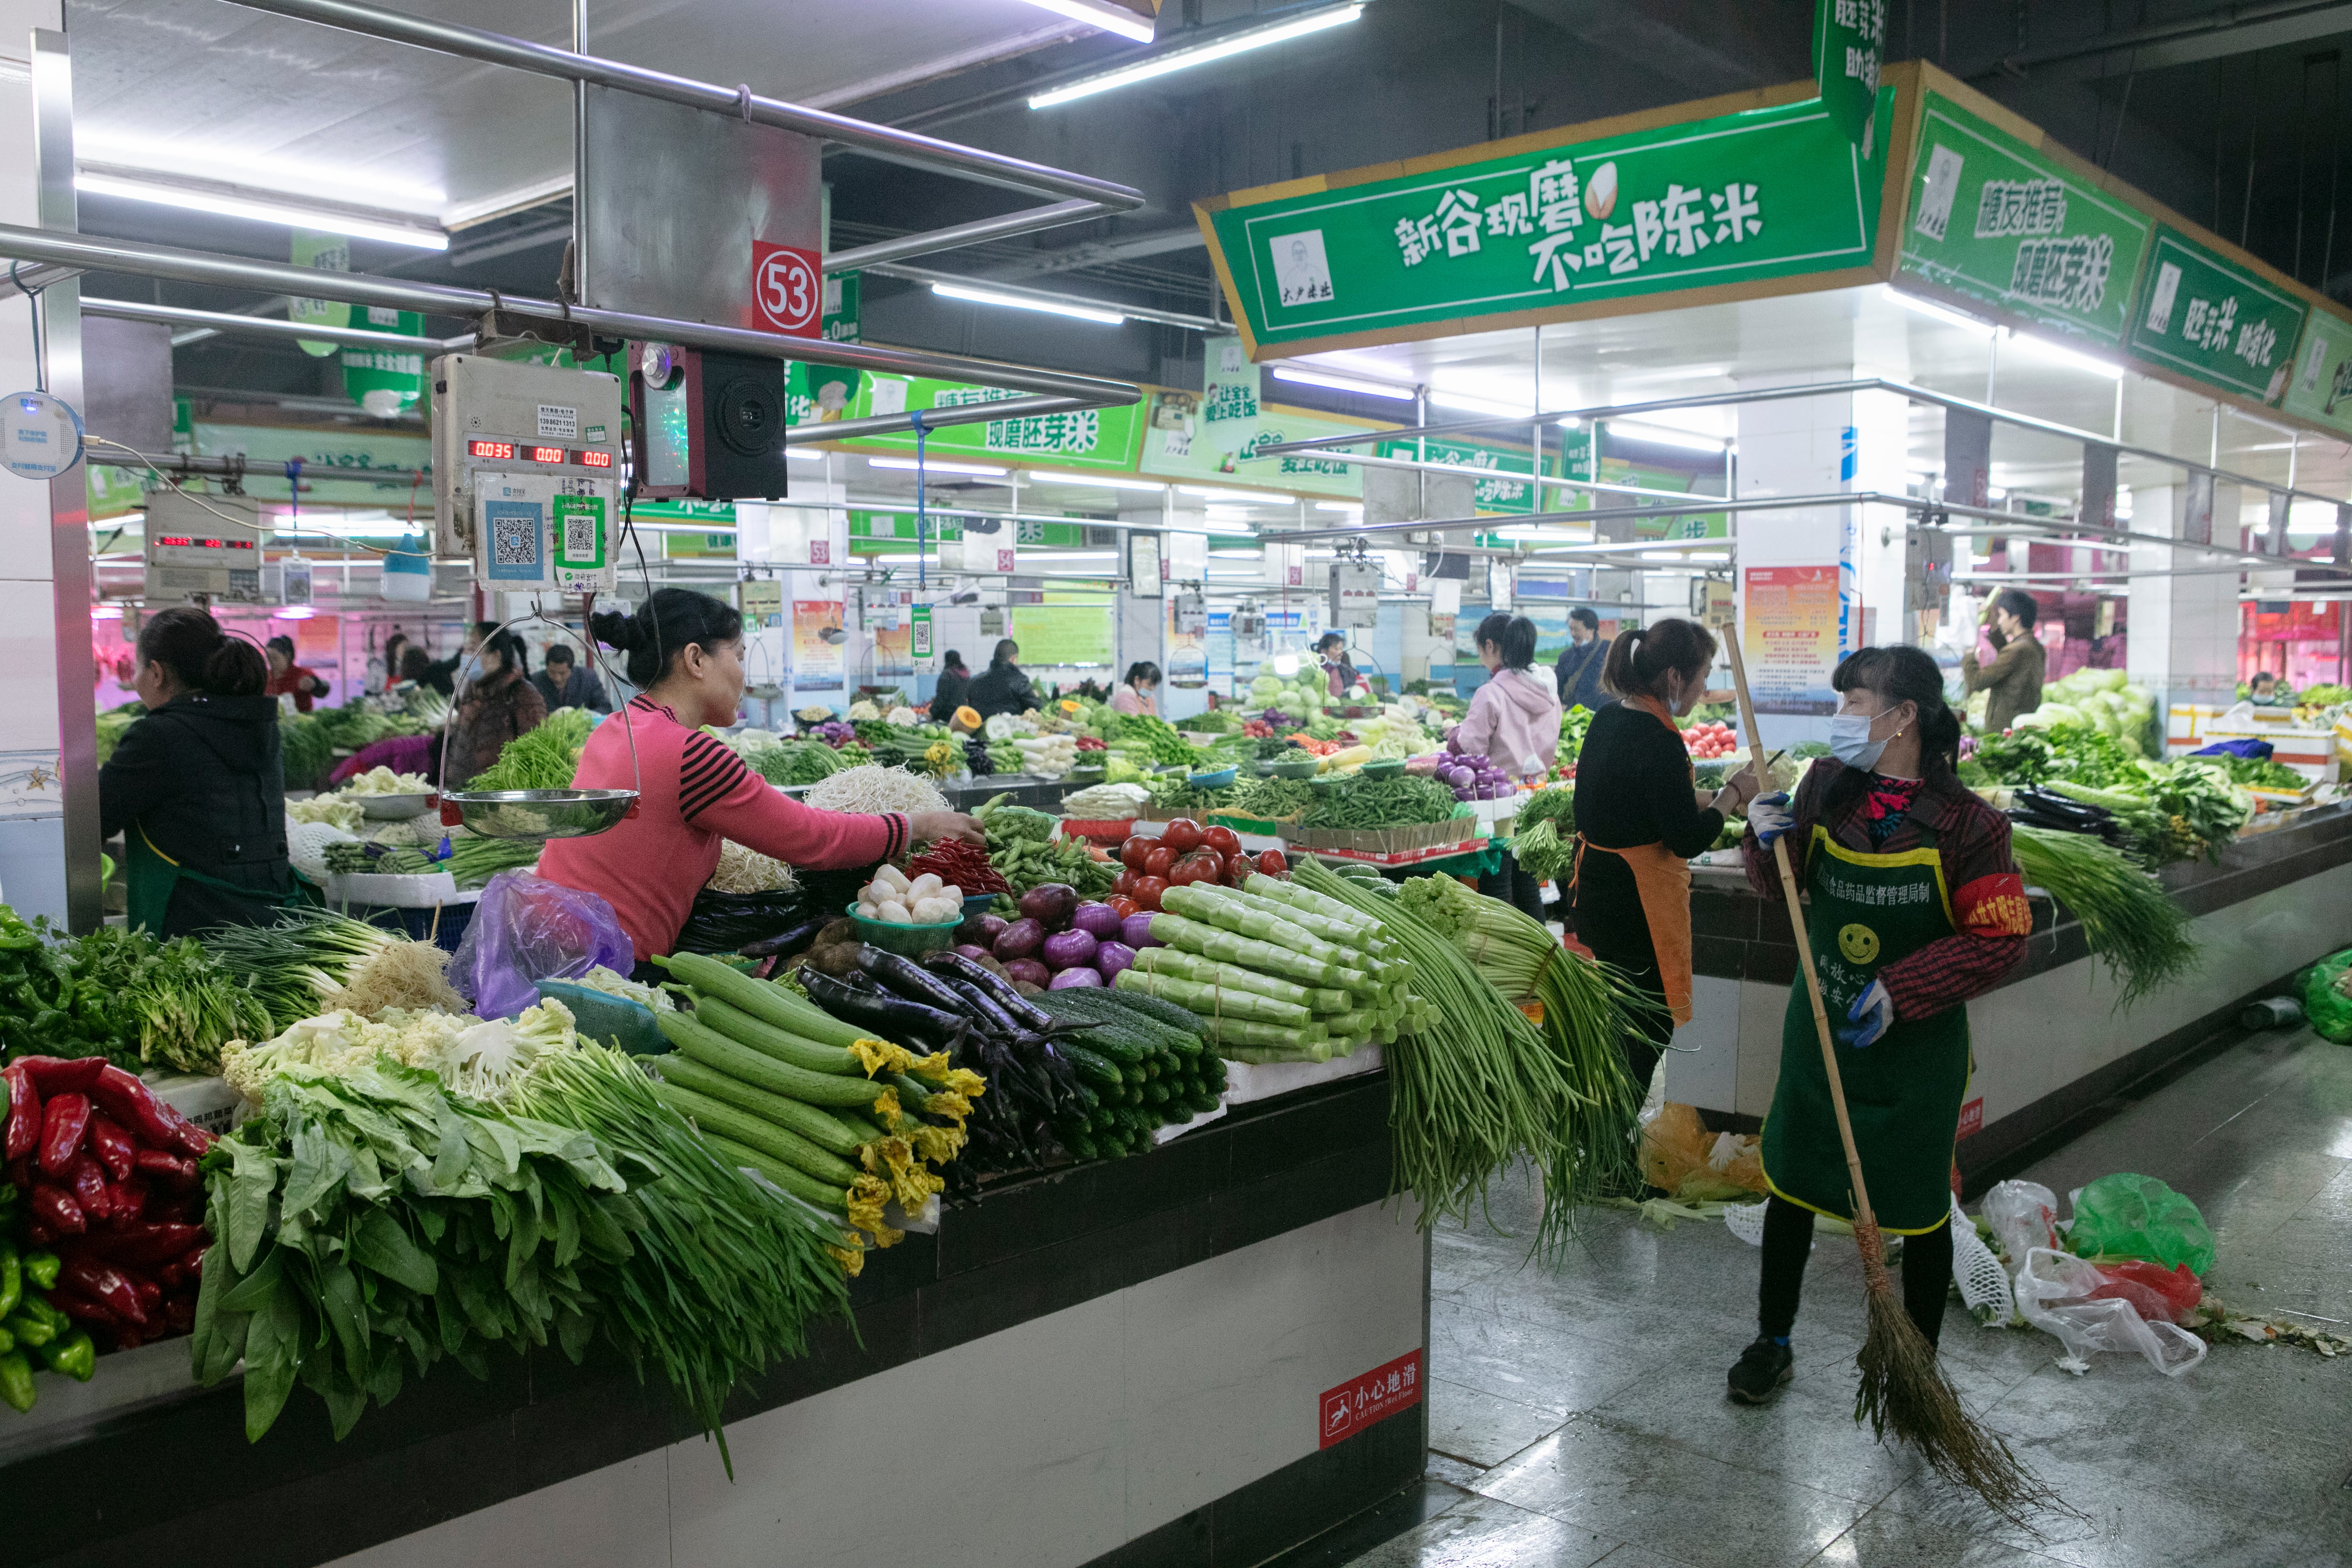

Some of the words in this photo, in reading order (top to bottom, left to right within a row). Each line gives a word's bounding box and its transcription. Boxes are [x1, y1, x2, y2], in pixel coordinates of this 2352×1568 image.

[1394, 159, 1583, 268] 新谷现磨
[1528, 183, 1763, 293] 不吃陈米
[767, 263, 808, 317] 53
[988, 410, 1097, 450] 现磨胚芽米
[476, 442, 511, 458] 0.035
[536, 447, 562, 462] 0.00
[585, 452, 609, 466] 0.00
[1354, 1362, 1416, 1409] 小心地滑
[1355, 1402, 1383, 1420] CAUTION
